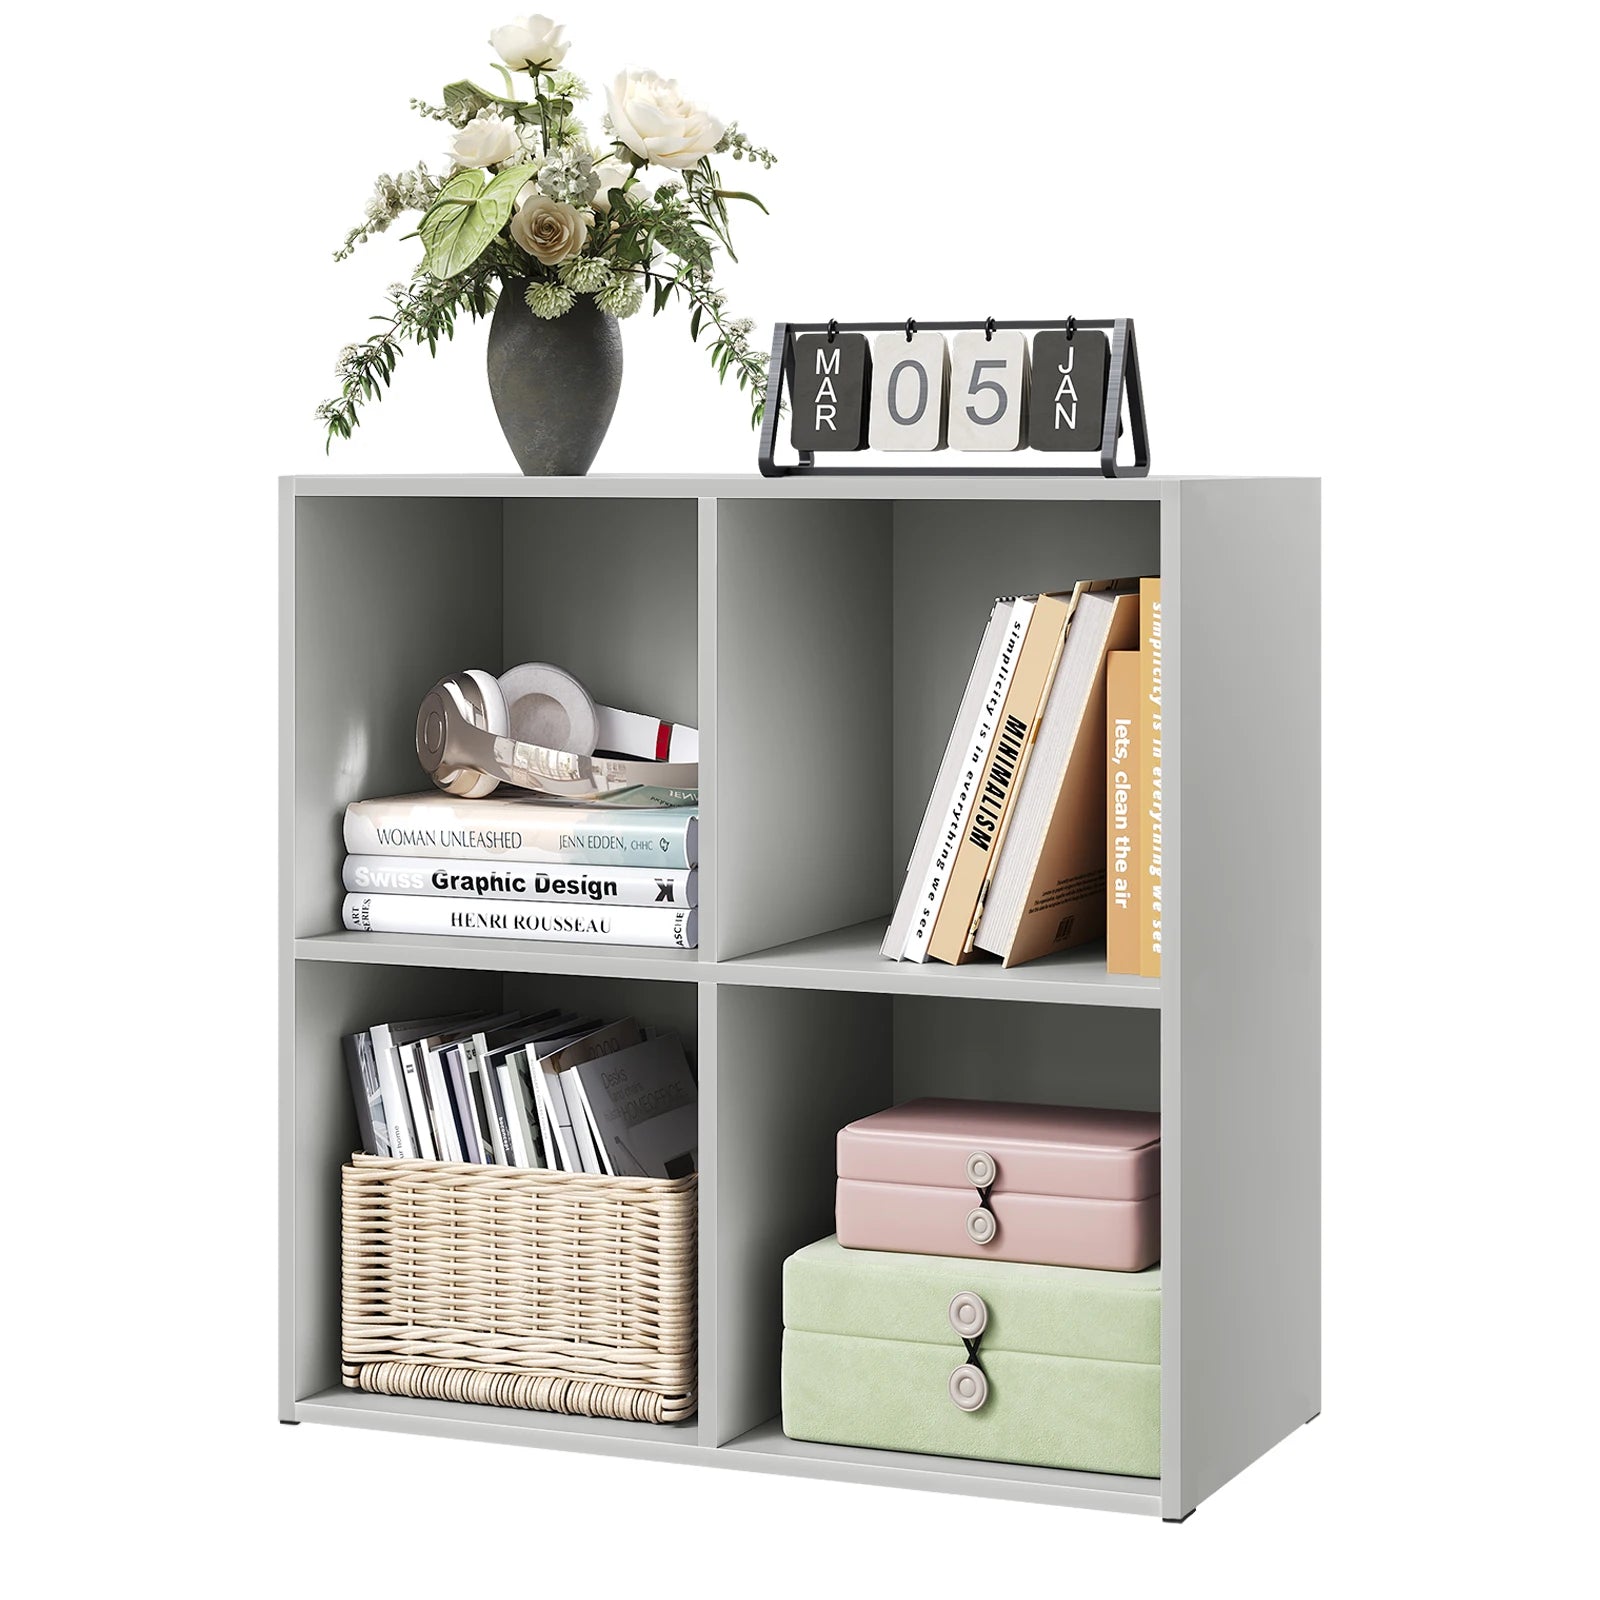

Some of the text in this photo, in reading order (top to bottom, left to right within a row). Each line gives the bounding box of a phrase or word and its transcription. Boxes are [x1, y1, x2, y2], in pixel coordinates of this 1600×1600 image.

[814, 348, 841, 431] MAR
[887, 359, 1009, 426] 0 5
[1054, 346, 1079, 430] JAN
[916, 620, 1021, 938] simplicity is in everything we see
[969, 714, 1028, 852] MINIMALISM
[1112, 719, 1132, 909] lets, clean the air
[376, 828, 522, 850] WOMAN UNLEASHED
[559, 835, 585, 850] JENN
[588, 835, 627, 851] EDDEN,
[355, 865, 618, 900] Swiss Graphic Design
[351, 906, 360, 926] ART
[361, 898, 372, 932] SERIES
[451, 912, 612, 934] HENRI ROUSSEAU
[1153, 919, 1161, 954] see
